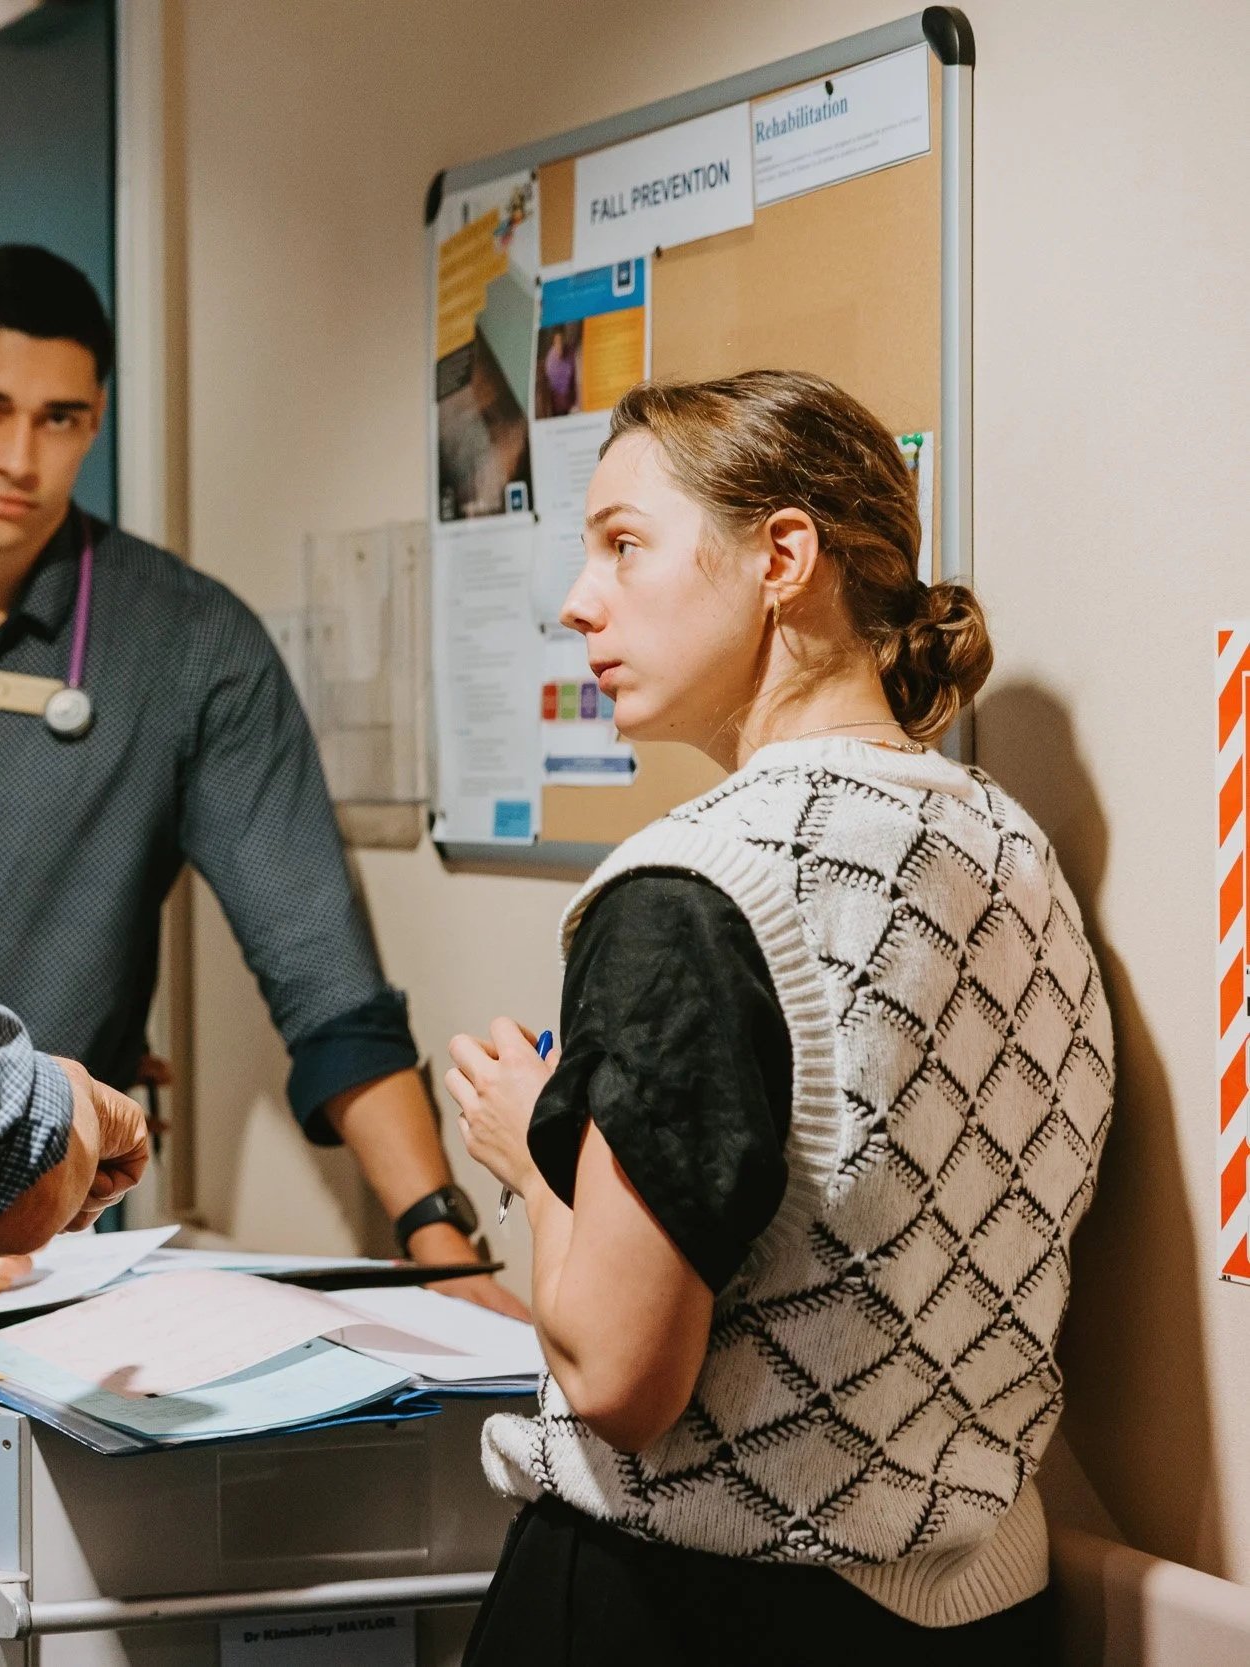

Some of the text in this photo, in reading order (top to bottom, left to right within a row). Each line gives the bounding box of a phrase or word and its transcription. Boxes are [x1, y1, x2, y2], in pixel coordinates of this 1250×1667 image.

[755, 97, 848, 145] Rehabilitation
[590, 192, 627, 225] FALL
[631, 158, 730, 210] PREVENTION
[244, 1631, 259, 1643] Dr
